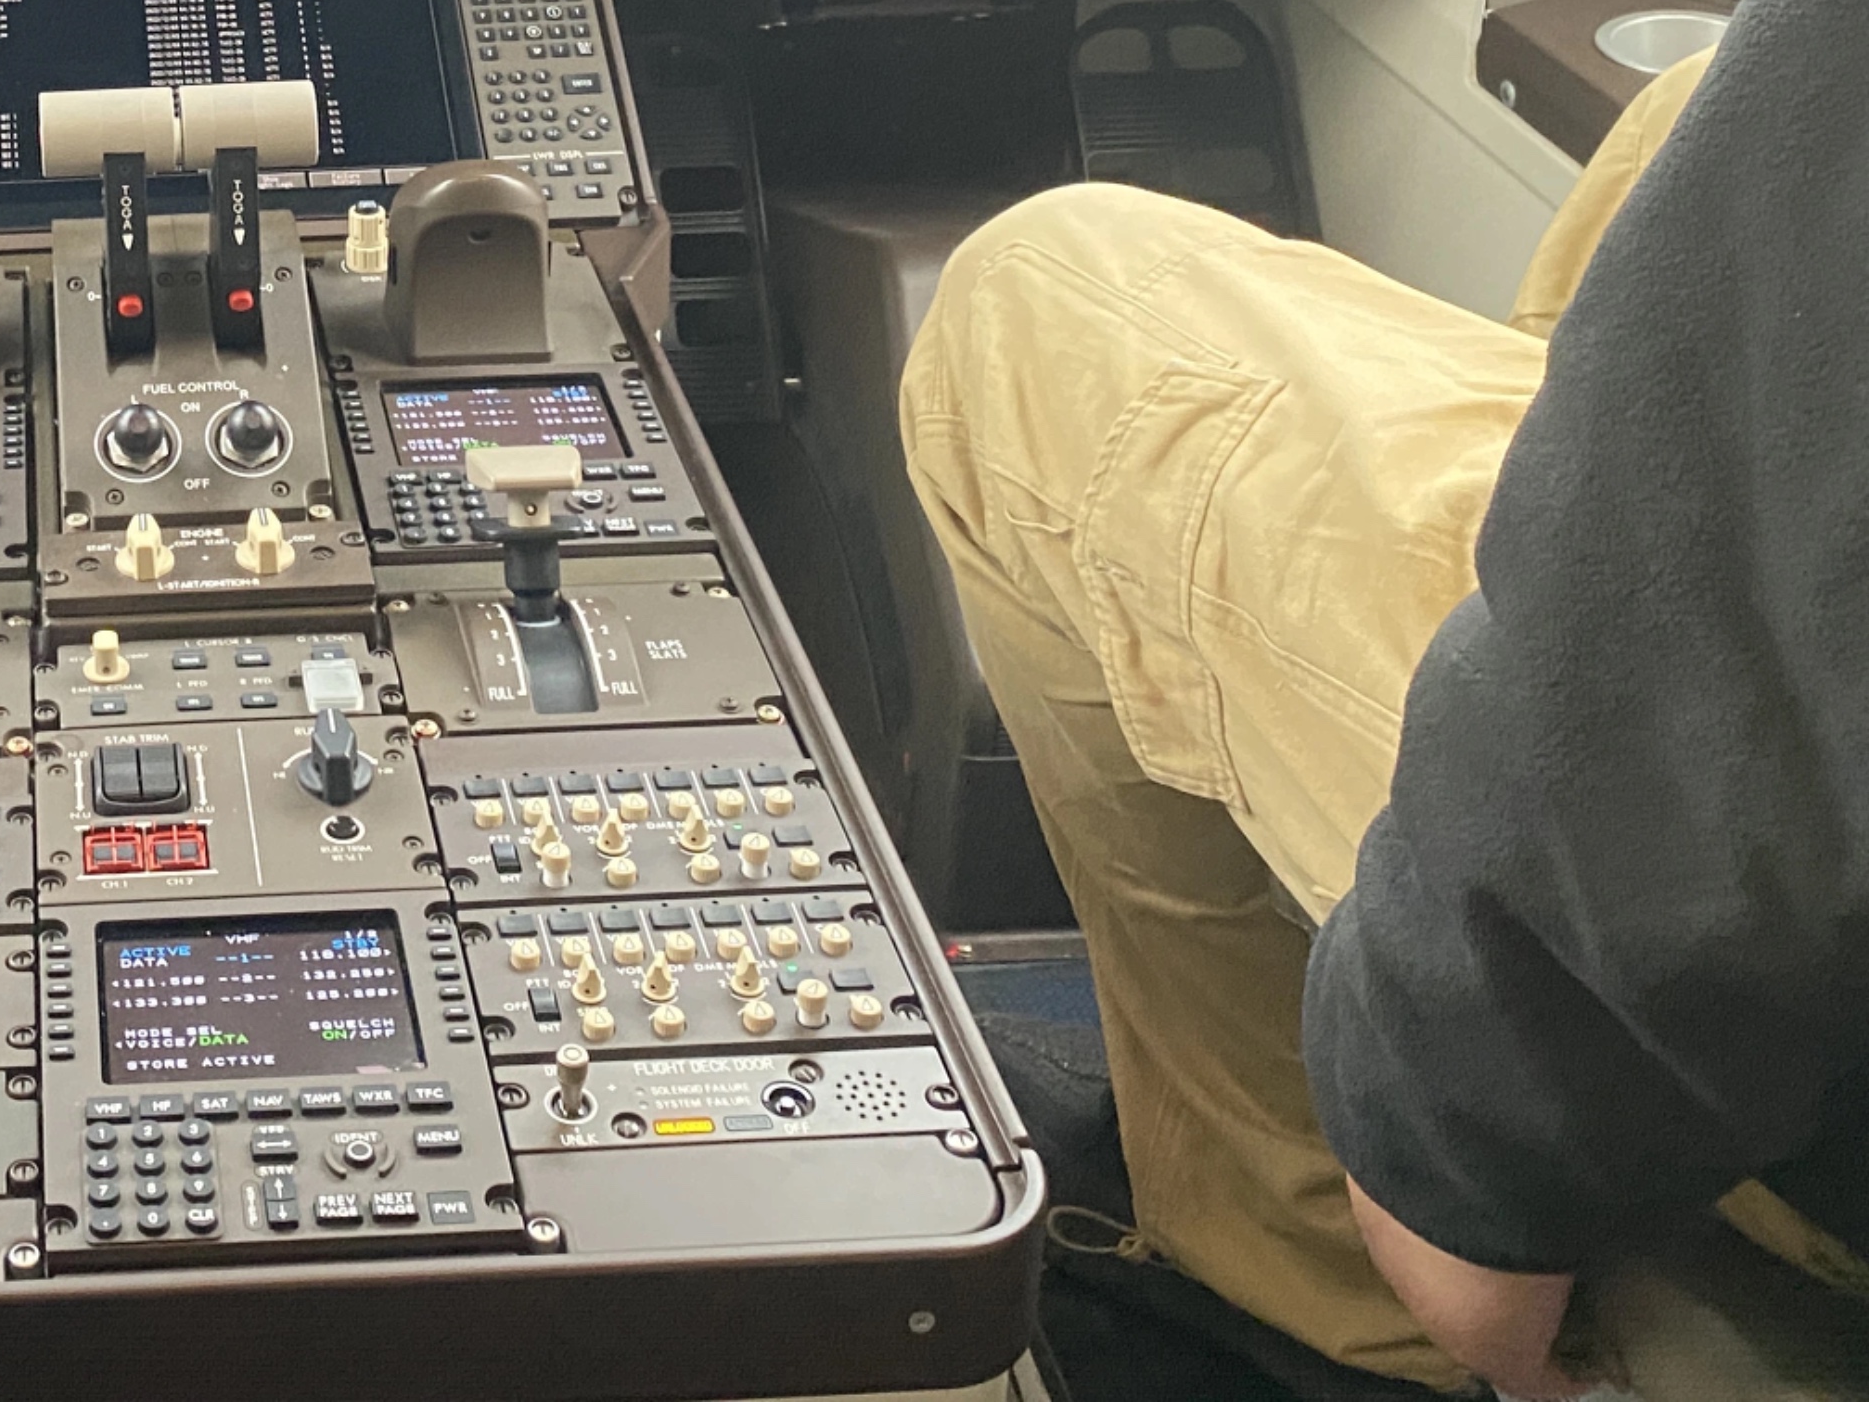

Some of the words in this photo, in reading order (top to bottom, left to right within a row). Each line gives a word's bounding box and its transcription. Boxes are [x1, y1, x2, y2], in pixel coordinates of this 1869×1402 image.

[120, 185, 133, 230] TOGA
[232, 179, 244, 225] TOGA
[143, 382, 175, 395] FUEL
[178, 380, 239, 393] CONTROL
[131, 394, 139, 404] L
[239, 389, 249, 400] R
[181, 401, 200, 413] ON
[184, 478, 210, 490] OFF
[180, 529, 223, 538] ENGINE
[490, 629, 499, 640] 2
[600, 624, 609, 635] 2
[646, 640, 683, 650] FLAPS
[497, 654, 505, 666] 3
[608, 649, 617, 662] 3
[649, 649, 687, 660] SLATS
[611, 681, 638, 695] FULL
[489, 687, 515, 701] FULL
[105, 735, 135, 744] STAB
[140, 734, 169, 743] TRIM
[225, 933, 260, 944] VHF
[332, 936, 378, 949] STBY
[120, 945, 191, 958] ACTIVE
[120, 958, 168, 968] DATA
[309, 1018, 394, 1030] SQUELCH
[125, 1027, 172, 1038] MODE
[186, 1025, 222, 1036] SEL
[322, 1029, 395, 1040] ON/OFF
[126, 1034, 249, 1049] VOICE/DATA
[127, 1059, 188, 1070] STORE
[202, 1055, 275, 1067] ACTIVE
[633, 1062, 686, 1076] FLIGHT
[690, 1060, 731, 1073] DECK
[734, 1058, 774, 1072] DOOR
[416, 1088, 444, 1098] TFC
[650, 1086, 702, 1096] SOLENOID
[704, 1083, 750, 1093] FAILURE
[253, 1096, 282, 1106] NAV
[304, 1093, 341, 1104] TAWS
[360, 1091, 393, 1101] WXR
[94, 1103, 122, 1114] VHF
[153, 1101, 171, 1111] HF
[201, 1098, 228, 1109] SAT
[654, 1100, 702, 1110] SYSTEM
[707, 1096, 752, 1106] FAILURE
[98, 1128, 104, 1139] 1
[143, 1125, 153, 1136] 2
[189, 1123, 199, 1134] 3
[784, 1122, 810, 1134] OFF
[416, 1130, 460, 1142] MENU
[560, 1134, 598, 1146] UNLK
[98, 1156, 108, 1166] 4
[145, 1153, 154, 1164] 5
[192, 1151, 202, 1161] 6
[99, 1185, 108, 1196] 7
[147, 1182, 156, 1194] 8
[194, 1180, 204, 1191] 9
[319, 1194, 355, 1205] PREV
[374, 1192, 413, 1204] NEXT
[320, 1205, 358, 1217] PAGE
[377, 1204, 415, 1215] PAGE
[434, 1202, 468, 1213] PWR
[148, 1212, 158, 1223] 0
[188, 1209, 214, 1220] CLR
